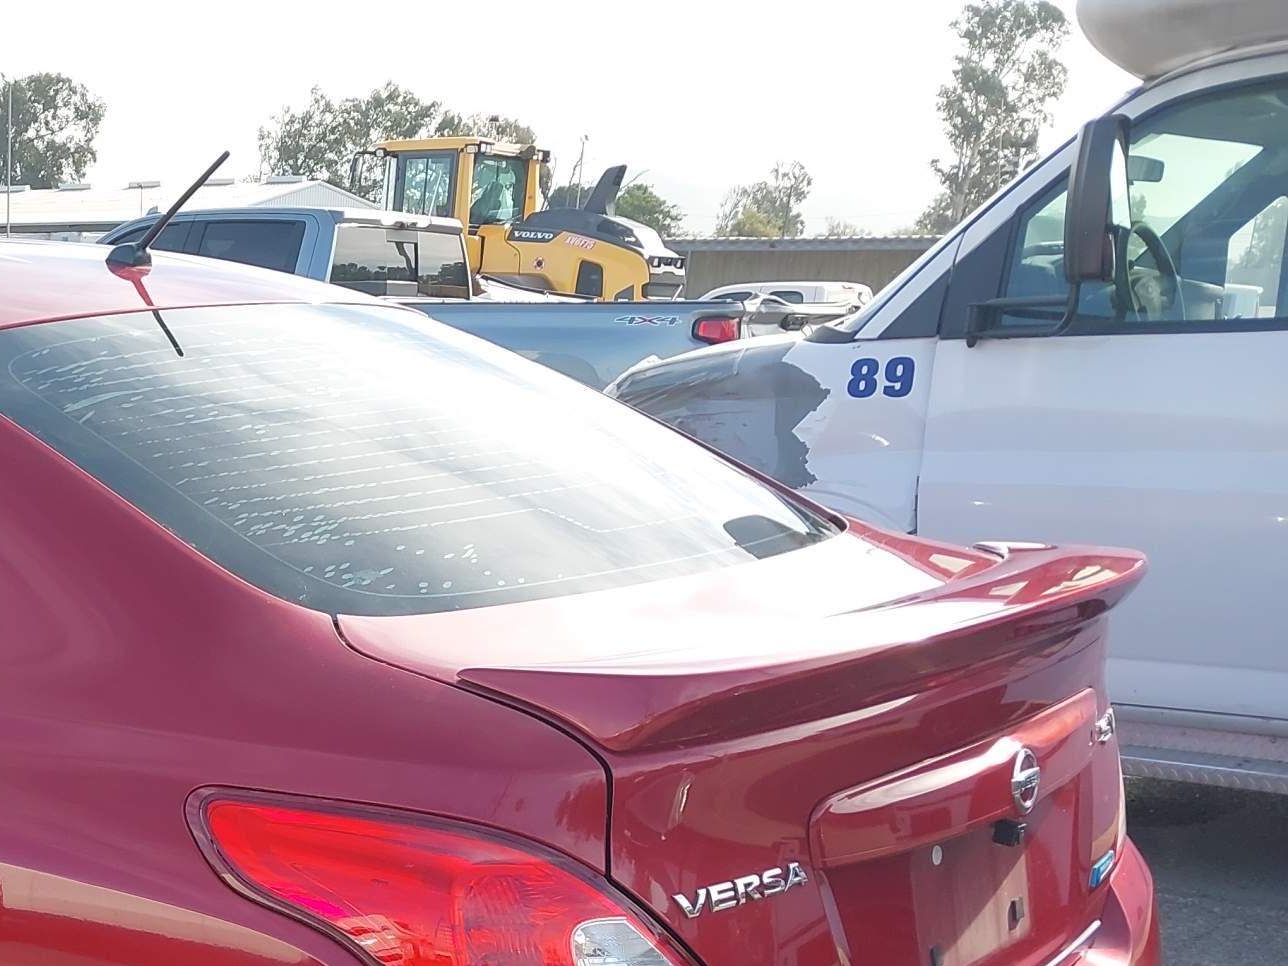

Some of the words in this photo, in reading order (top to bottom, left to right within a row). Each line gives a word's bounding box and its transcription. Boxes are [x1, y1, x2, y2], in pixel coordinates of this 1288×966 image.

[514, 230, 554, 239] VOLVO
[847, 357, 915, 398] 89
[672, 862, 808, 918] VERSA
